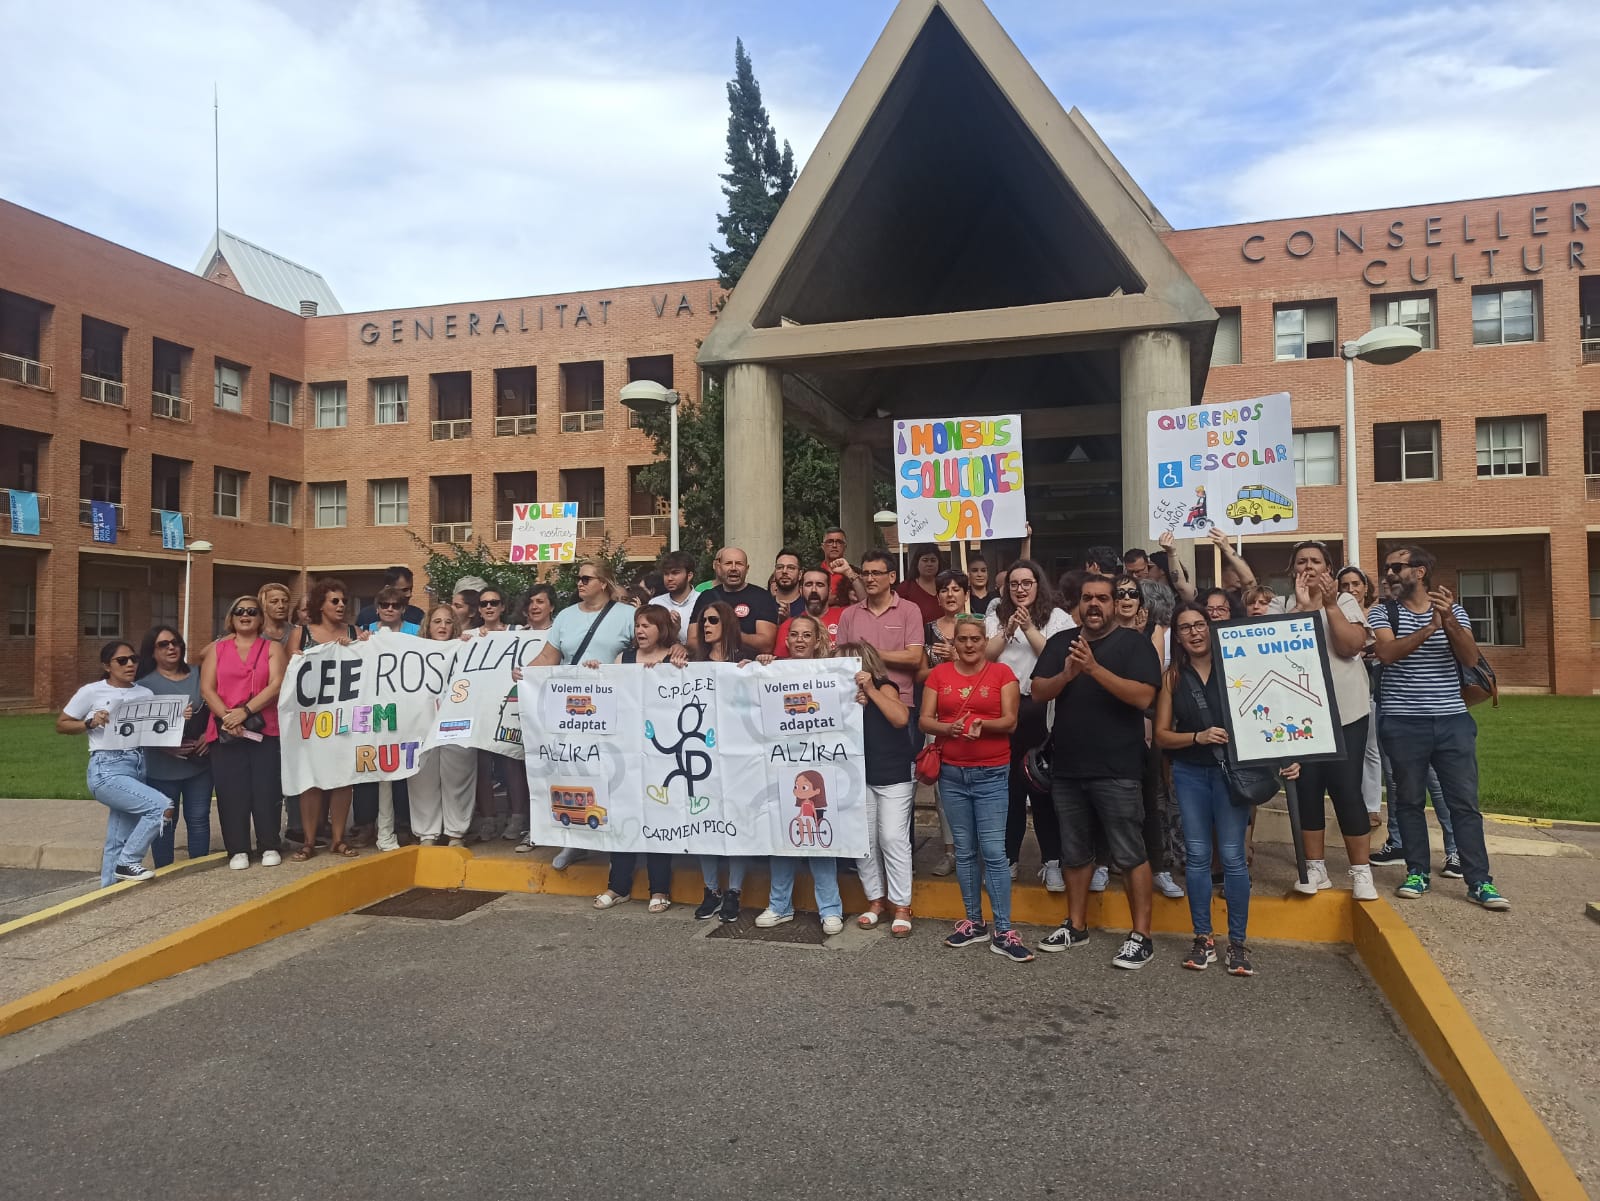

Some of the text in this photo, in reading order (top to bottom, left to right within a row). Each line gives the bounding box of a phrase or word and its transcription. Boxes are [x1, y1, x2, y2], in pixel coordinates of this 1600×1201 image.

[1242, 201, 1591, 262] CONSELLER
[1363, 241, 1586, 286] CULTUR
[360, 287, 718, 344] GENERALITAT VAL
[1157, 403, 1264, 431] QUEREMOS
[897, 418, 1012, 456] ¡MONBUS
[1207, 429, 1248, 448] BUS
[1189, 444, 1287, 471] ESCOLAR
[900, 451, 1023, 499] SOLUCIONES
[515, 503, 577, 520] VOLEM
[1153, 498, 1171, 520] CEE
[1163, 510, 1174, 522] LA
[934, 499, 995, 542] YA!
[511, 542, 574, 561] DRETS
[1221, 627, 1276, 640] COLEGIO
[1222, 634, 1315, 659] LA UNIÓN
[296, 658, 363, 708] CEE
[551, 683, 613, 694] Volem el bus
[764, 680, 836, 694] Volem el bus
[300, 703, 397, 740] VOLEM
[558, 718, 607, 732] adaptat
[779, 717, 836, 732] adaptat
[356, 741, 423, 774] RUT
[539, 743, 601, 763] ALZIRA
[771, 742, 849, 763] ALZIRA
[642, 820, 737, 842] CARMEN PICÓ
